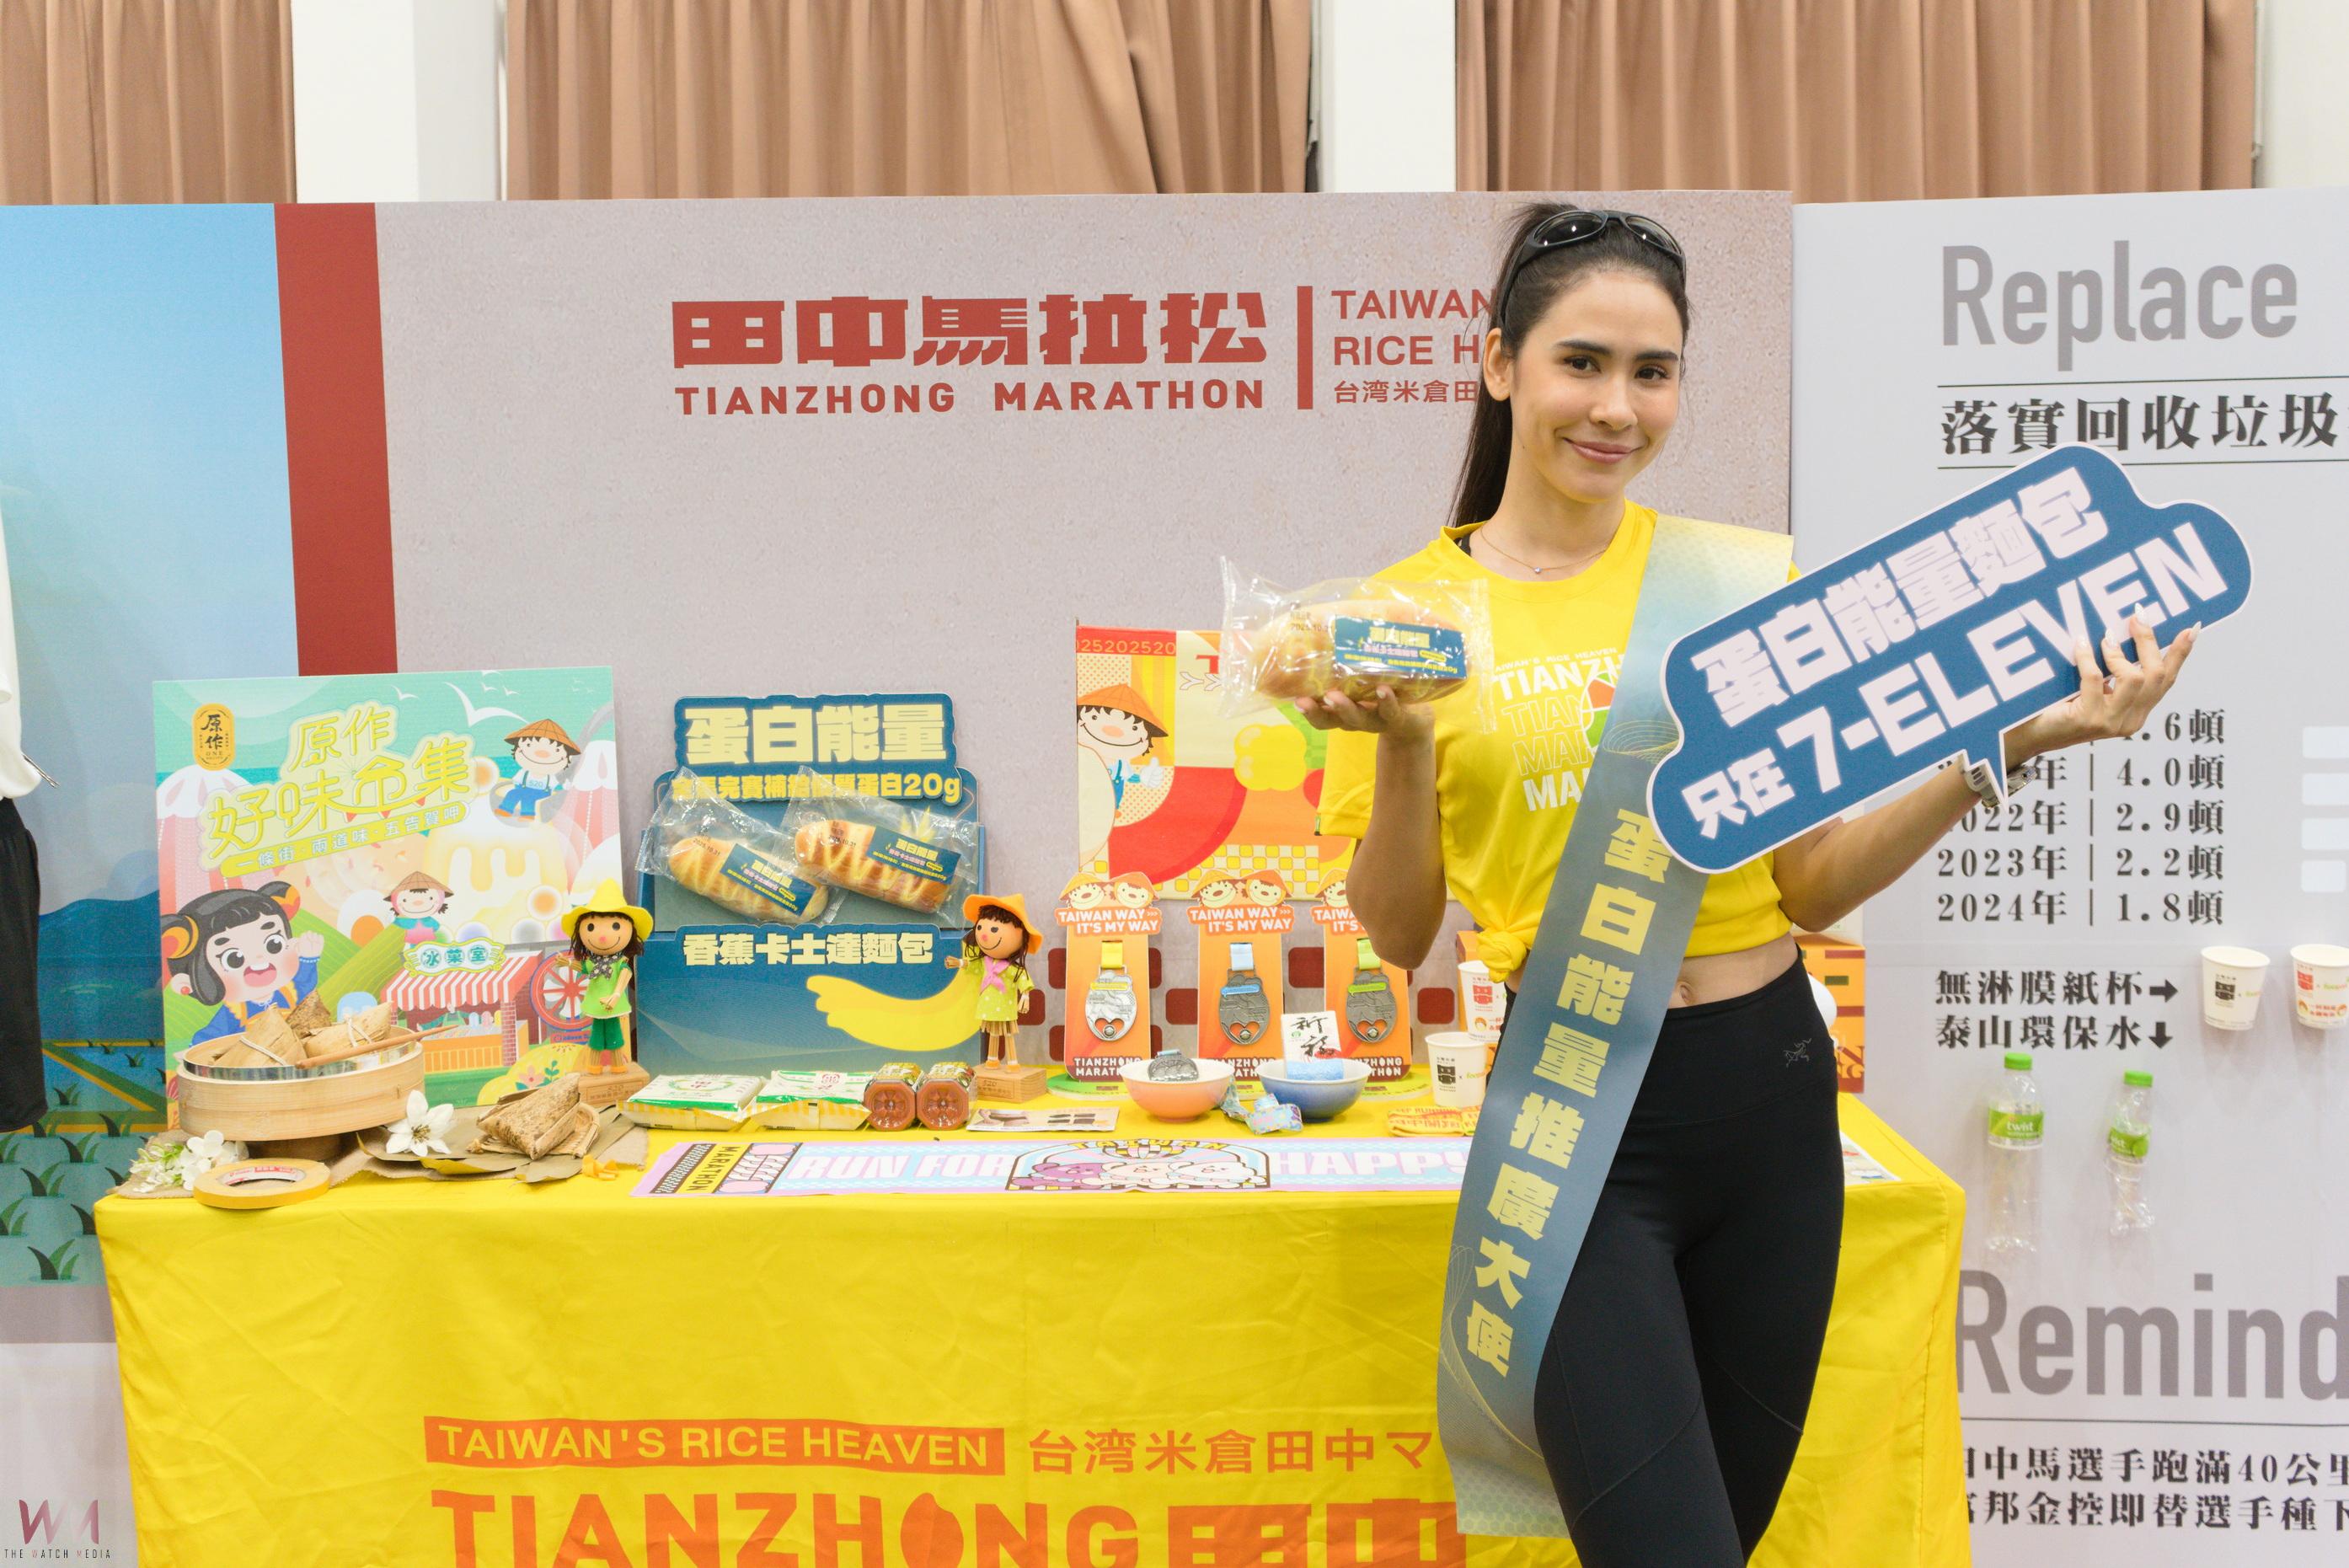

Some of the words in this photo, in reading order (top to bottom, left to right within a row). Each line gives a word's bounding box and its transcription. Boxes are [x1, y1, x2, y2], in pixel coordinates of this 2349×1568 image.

[1331, 289, 1496, 319] TAIWAN
[1943, 240, 2298, 372] Replace
[673, 292, 1267, 368] 田中馬拉松
[1335, 335, 1433, 366] RICE
[674, 383, 955, 415] TIANZHONG
[994, 379, 1265, 412] MARATHON
[1941, 392, 2339, 455] 落實回收垃圾
[1690, 466, 2108, 728] 蛋白能量麵包
[1077, 638, 1177, 656] 25202520
[1496, 657, 1541, 672] AIWAN'S
[201, 714, 223, 750] 原作
[289, 704, 393, 773] 原作
[685, 704, 946, 765] 蛋白能量
[2123, 709, 2225, 744] .6頓
[1948, 800, 2068, 835] 022年
[1938, 845, 2068, 880] 2023年
[1058, 910, 1112, 923] TAIWAN
[1116, 909, 1145, 920] WAY
[1190, 908, 1244, 921] TAIWAN
[1247, 907, 1277, 918] WAY
[1938, 890, 2068, 925] 2024年
[1078, 923, 1101, 934] IT'S
[1105, 922, 1126, 932] MY
[1128, 920, 1158, 932] WAY
[1208, 921, 1233, 933] IT'S
[1237, 920, 1258, 931] MY
[1260, 918, 1292, 930] WAY
[1333, 920, 1358, 932] IT'S
[683, 932, 933, 966] 香蕉卡士達麵包
[1935, 970, 2142, 1006] 無淋膜紙杯
[1935, 1014, 2142, 1050] 泰山環保水
[1466, 808, 1674, 1378] 蛋白能量推廣大使
[1069, 1138, 1228, 1150] TAIWAN
[688, 1145, 739, 1192] MARATHON
[786, 1155, 911, 1179] RUN
[916, 1153, 1009, 1178] FOR
[1956, 1270, 2349, 1400] Remind
[438, 1425, 666, 1459] TAIWAN'S
[681, 1426, 786, 1458] RICE
[803, 1426, 987, 1468] HEAVEN
[431, 1489, 1138, 1568] TIANZHONG
